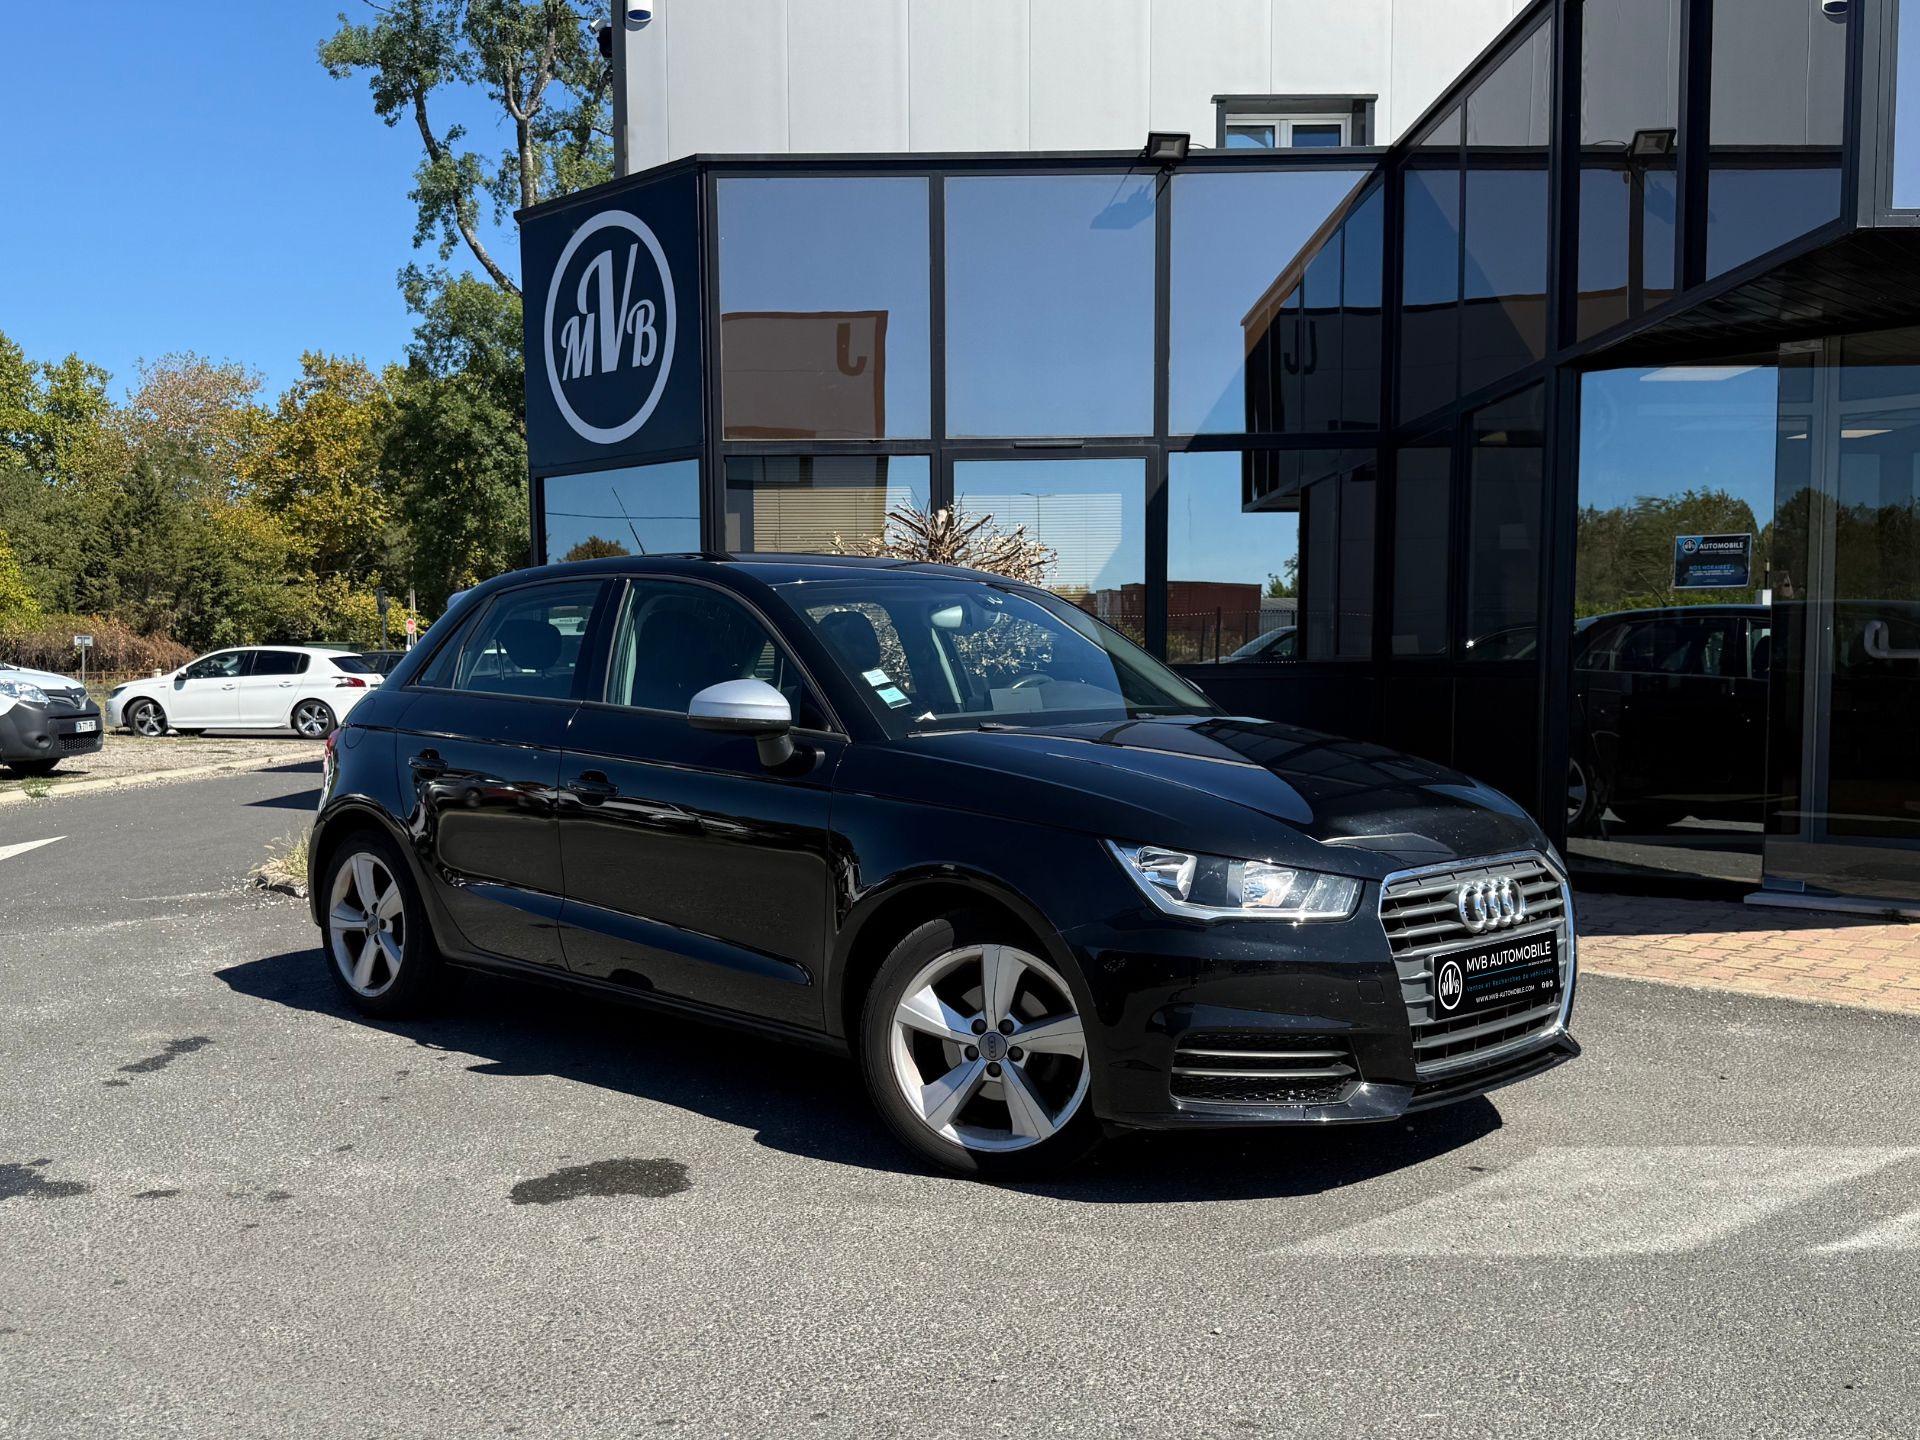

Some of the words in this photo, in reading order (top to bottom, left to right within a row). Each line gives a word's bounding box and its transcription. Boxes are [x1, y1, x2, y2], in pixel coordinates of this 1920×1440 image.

[560, 242, 658, 382] MVB
[1699, 542, 1744, 550] AUTOMOBILE
[1466, 955, 1488, 972] MVB
[1489, 941, 1551, 967] AUTOMOBILE
[1441, 967, 1460, 997] MVB
